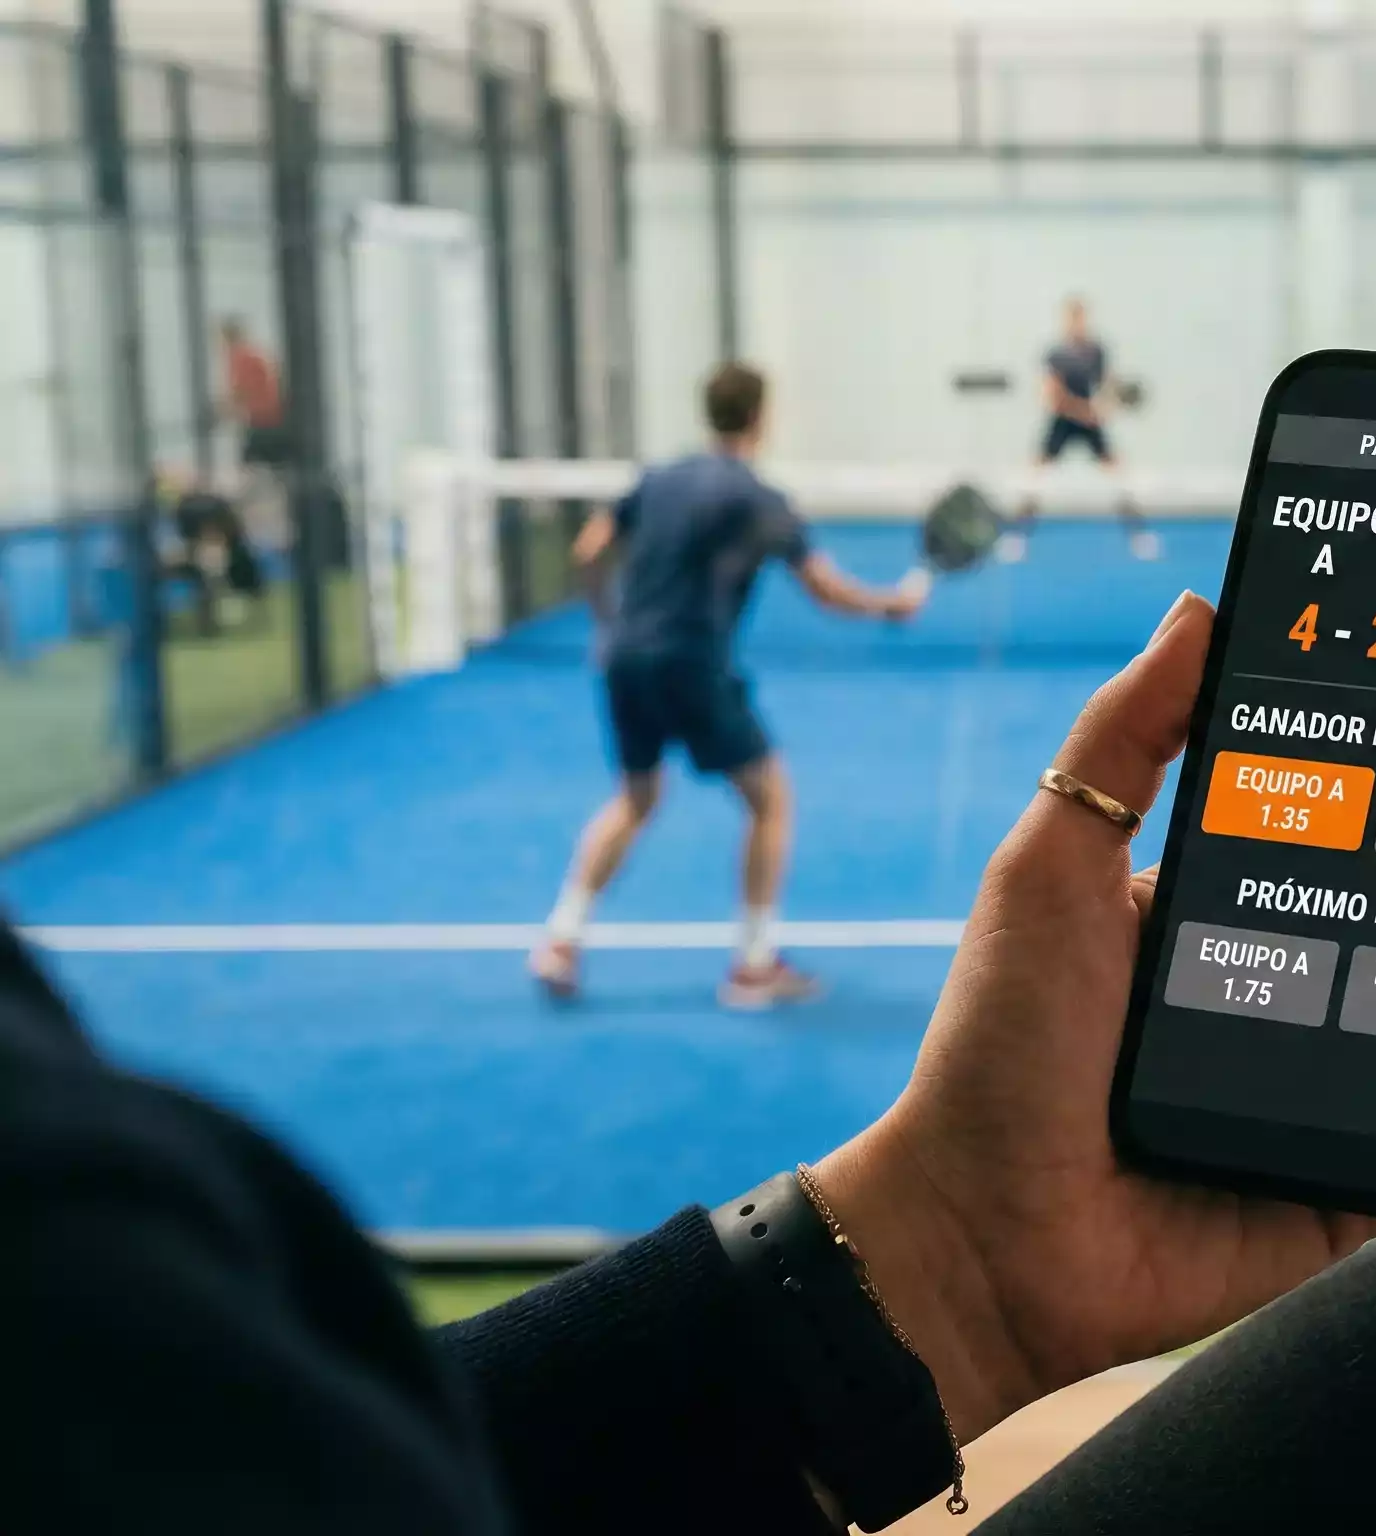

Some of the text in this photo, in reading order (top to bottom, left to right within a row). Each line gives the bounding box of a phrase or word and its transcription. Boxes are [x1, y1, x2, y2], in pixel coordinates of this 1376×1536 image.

[1311, 544, 1333, 574] A
[1289, 604, 1318, 651] 4
[1232, 704, 1365, 744] GANADOR
[1237, 767, 1343, 800] EQUIPO A
[1262, 805, 1310, 830] 1.35
[1237, 878, 1367, 921] PRÓXIMO
[1200, 938, 1308, 975] EQUIPO A
[1225, 978, 1272, 1005] 1.75
